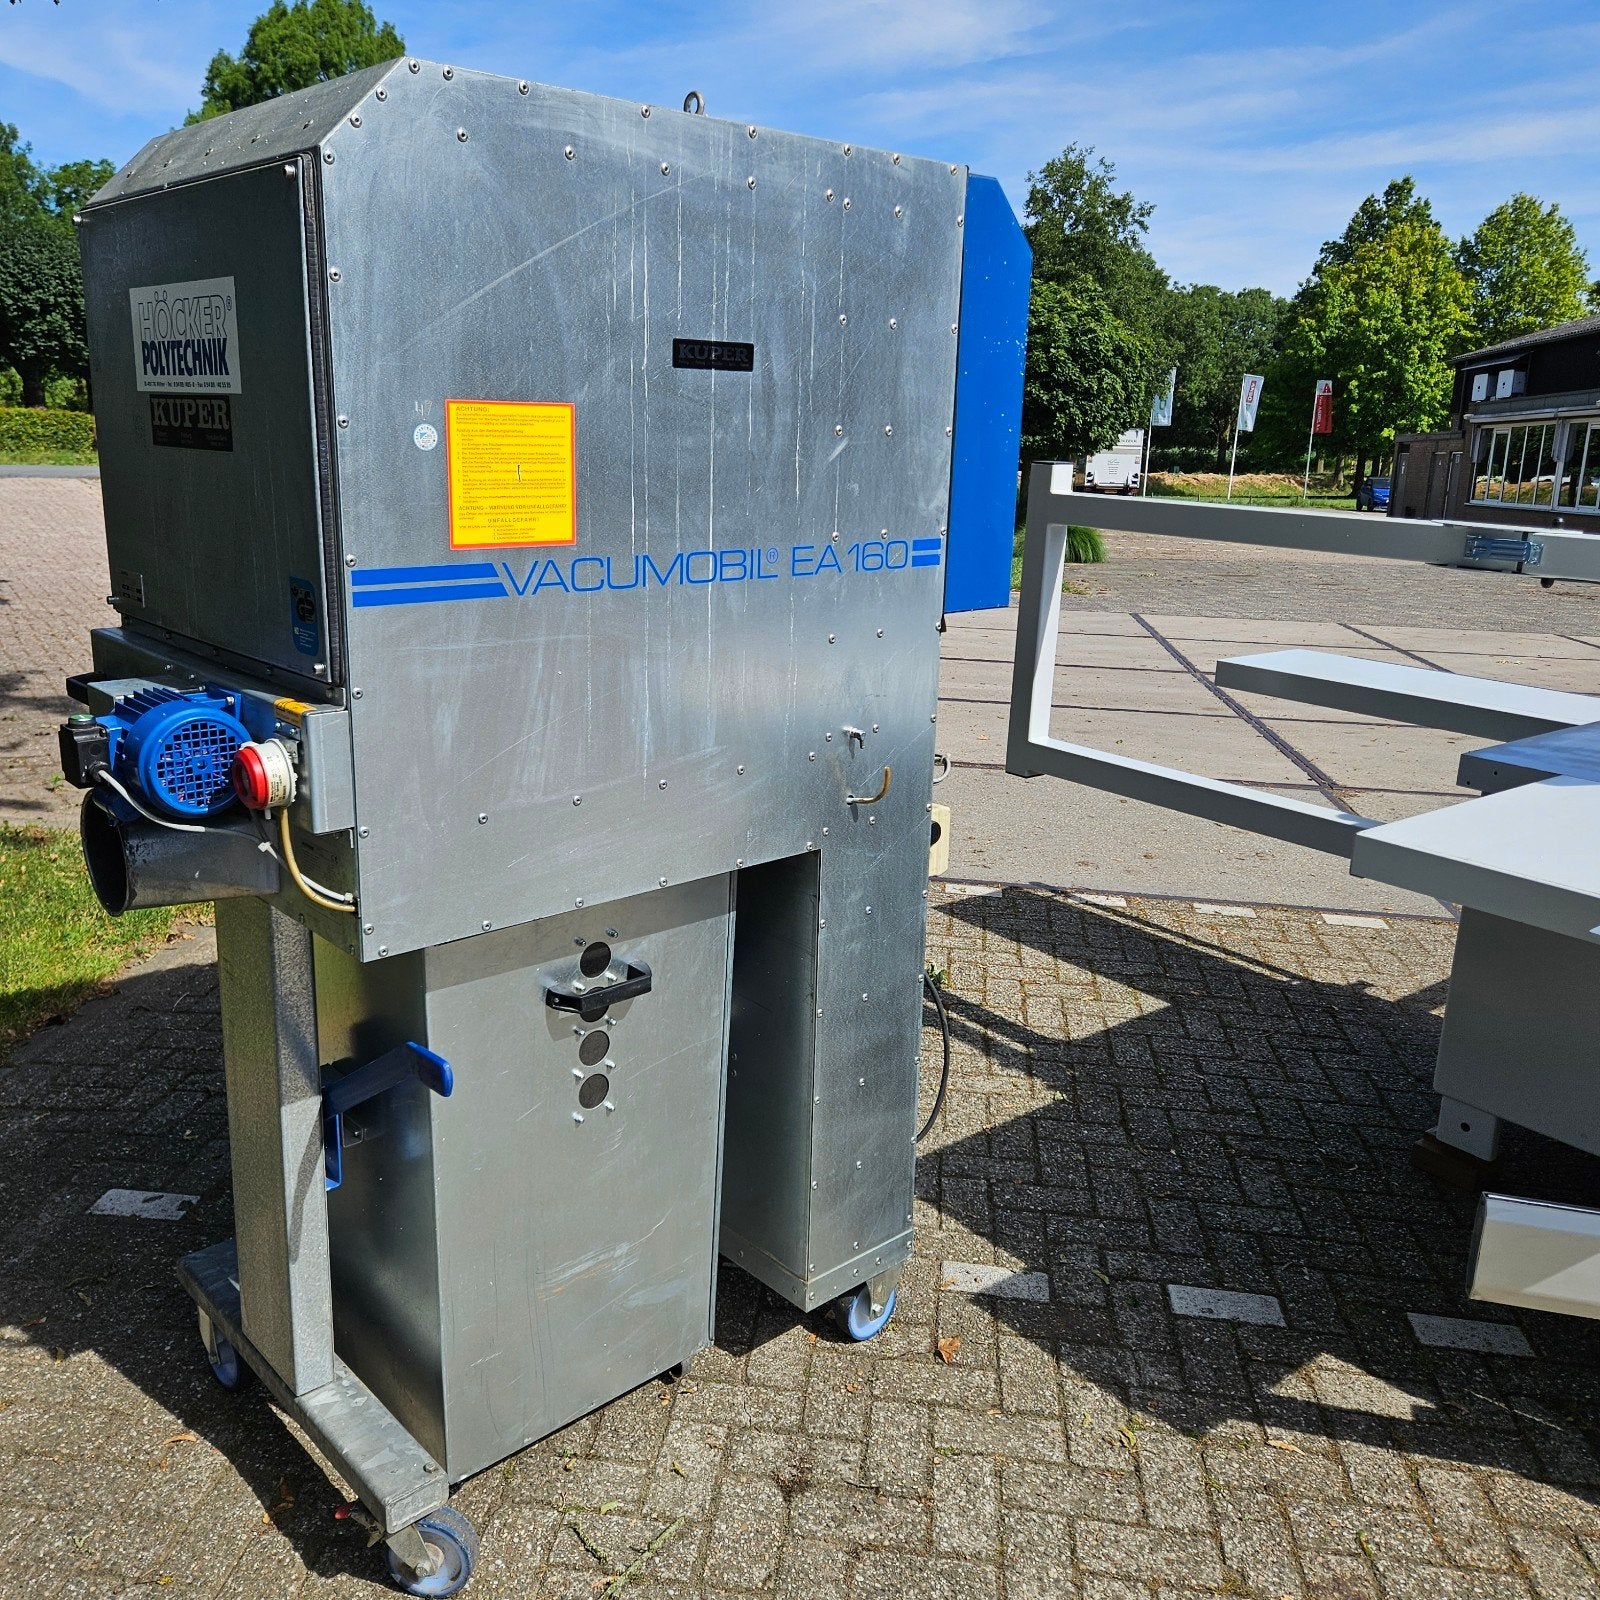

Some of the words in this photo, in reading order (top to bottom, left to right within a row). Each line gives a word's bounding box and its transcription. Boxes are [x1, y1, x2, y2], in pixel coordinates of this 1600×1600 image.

[141, 337, 230, 376] POLYTECHNIK
[678, 344, 749, 361] KUPER
[151, 398, 230, 430] KUPER
[790, 543, 842, 576] EA
[847, 540, 909, 572] 160
